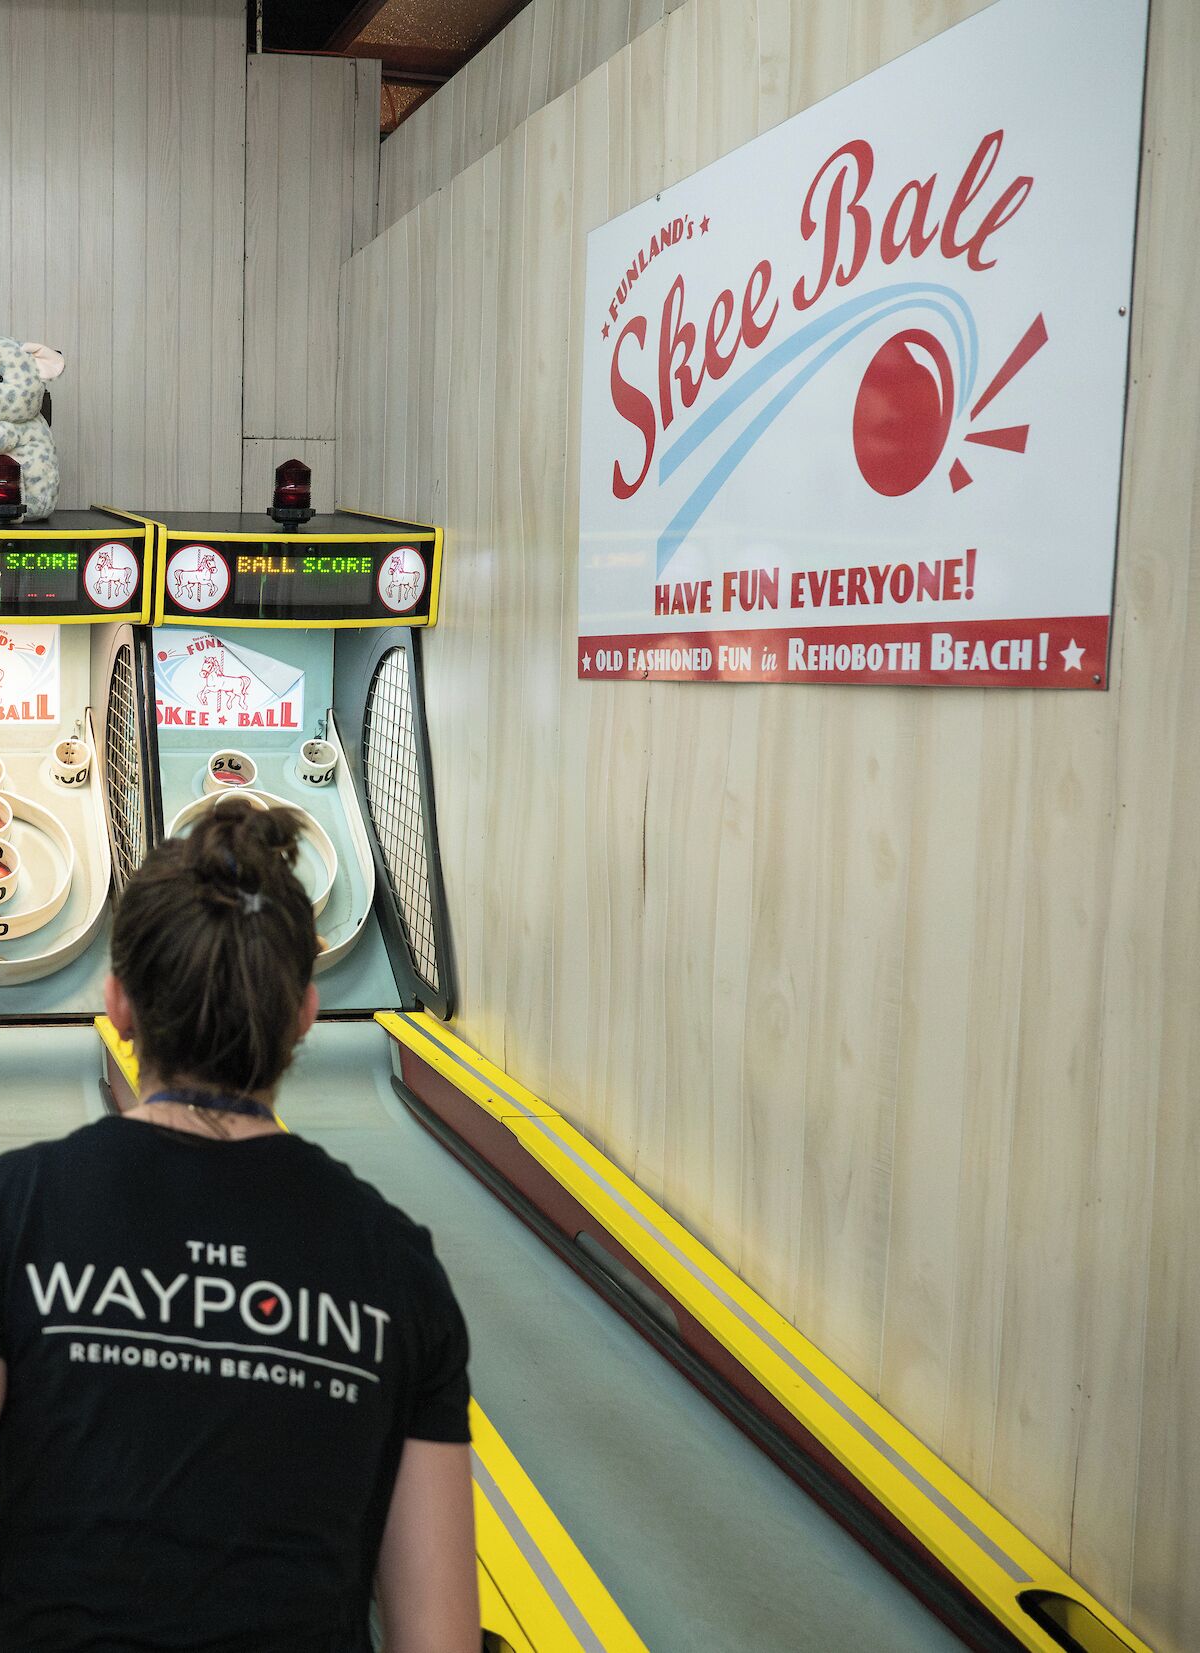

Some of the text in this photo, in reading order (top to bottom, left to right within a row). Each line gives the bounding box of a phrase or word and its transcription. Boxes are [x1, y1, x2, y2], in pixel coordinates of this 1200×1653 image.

[610, 129, 1034, 500] Skee Ball
[6, 553, 78, 570] SCORE
[237, 556, 372, 574] BALL SCORE
[654, 548, 978, 616] HAVE FUN EVERYONE!
[596, 632, 1050, 672] OLD FASHIONED FUN in REHOBOTH BEACH!
[237, 701, 298, 728] BALL
[186, 1240, 247, 1268] THE
[25, 1261, 391, 1364] WAYPOINT
[69, 1342, 359, 1404] REHOBOTH BEACH DE
